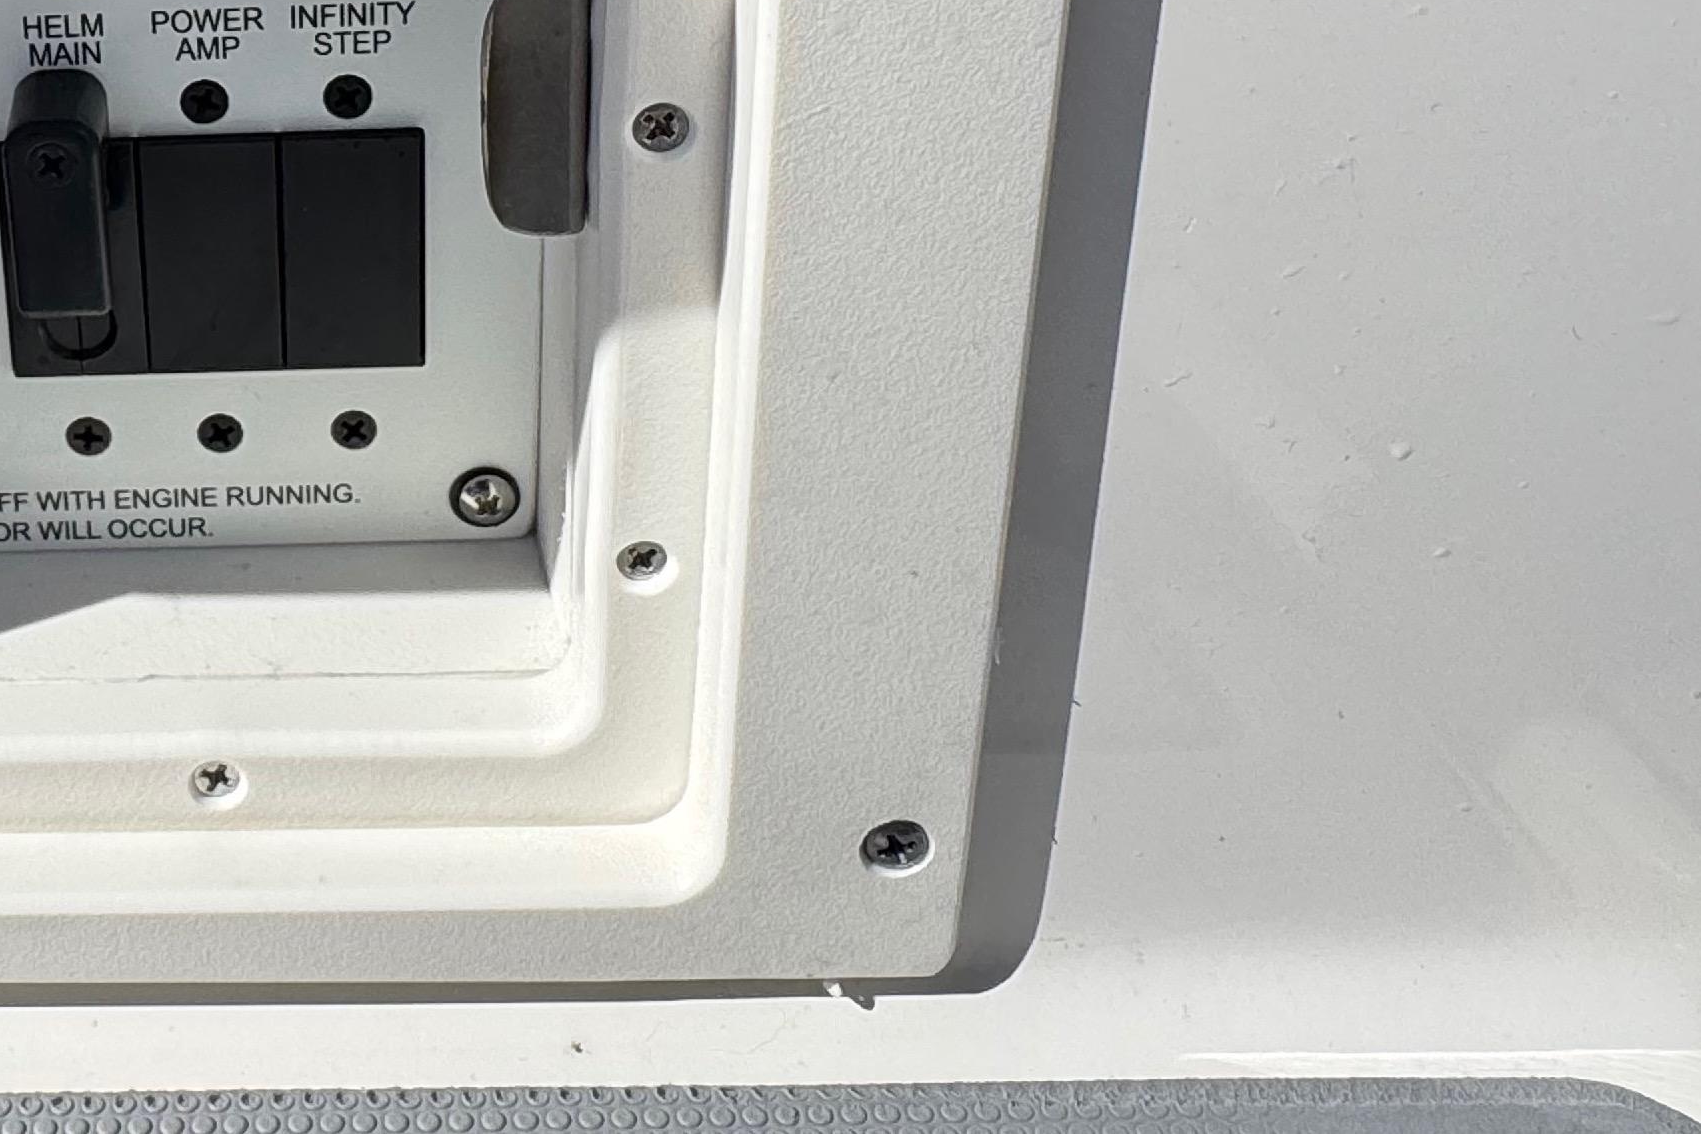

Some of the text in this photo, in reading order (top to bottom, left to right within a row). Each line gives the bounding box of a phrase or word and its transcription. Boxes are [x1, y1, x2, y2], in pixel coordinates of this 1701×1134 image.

[22, 13, 104, 39] HELM
[150, 6, 264, 35] POWER
[289, 0, 416, 30] INFINITY
[28, 41, 102, 66] MAIN
[175, 37, 240, 61] AMP
[312, 30, 392, 56] STEP
[36, 490, 106, 512] WITH
[114, 486, 218, 510] ENGINE
[226, 483, 362, 506] RUNNING.
[37, 520, 102, 540] WILL
[107, 516, 214, 540] OCCUR.
